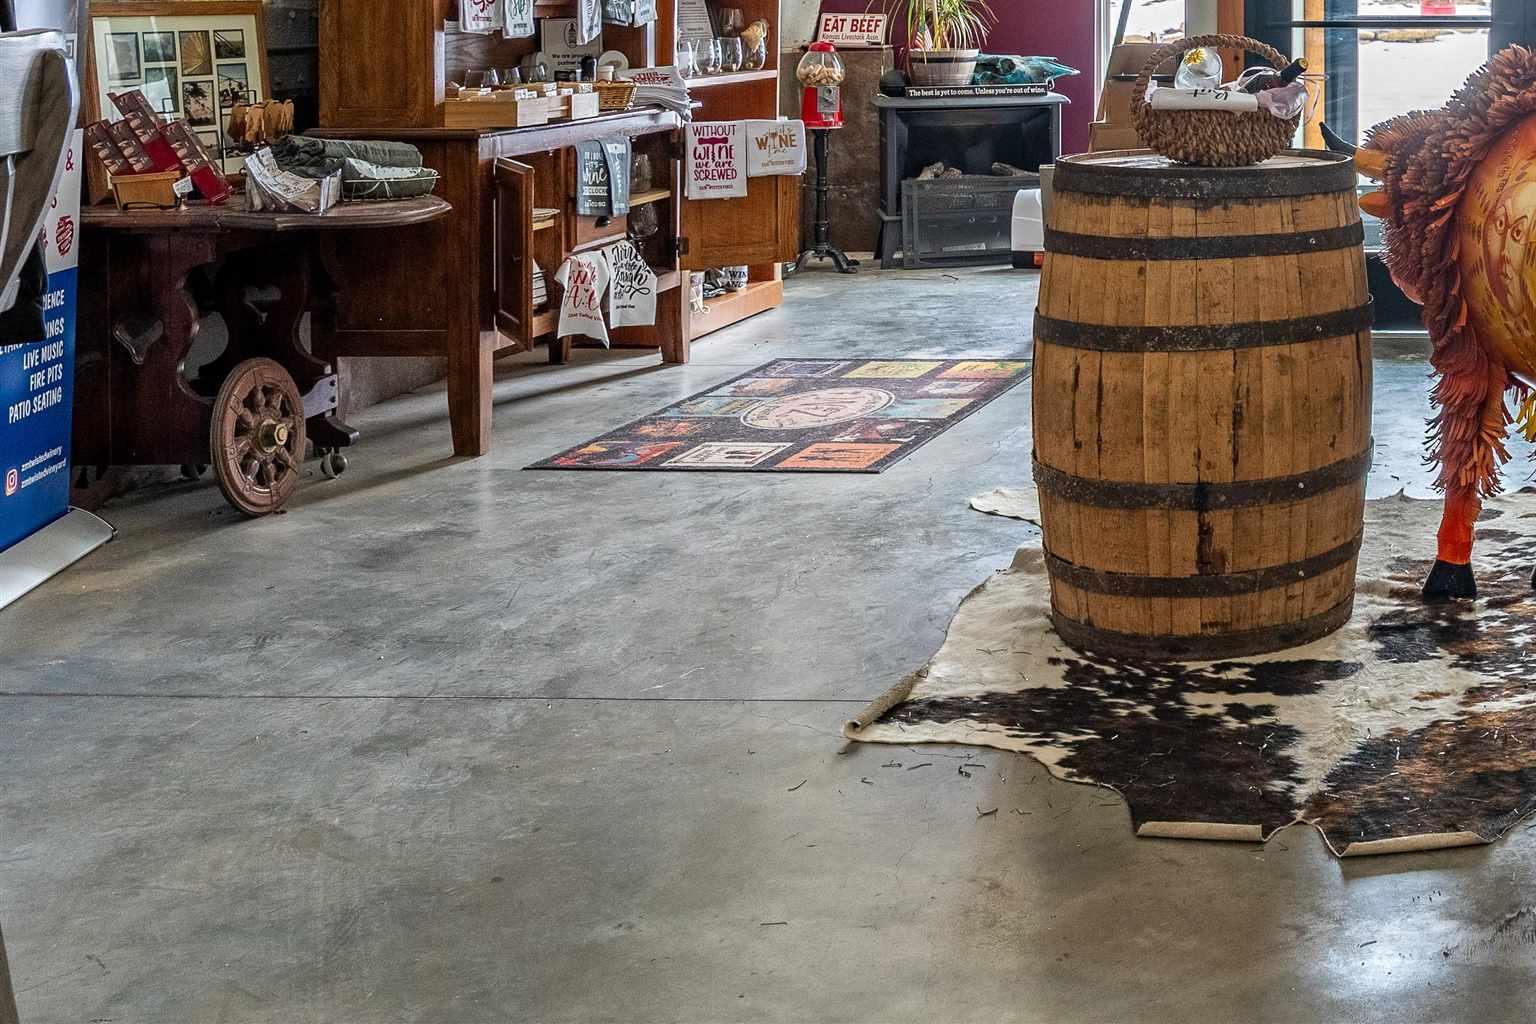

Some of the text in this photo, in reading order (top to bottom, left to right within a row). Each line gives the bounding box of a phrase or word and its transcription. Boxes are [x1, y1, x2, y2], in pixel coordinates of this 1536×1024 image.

[823, 18, 882, 33] EAT BEEF
[841, 33, 865, 41] Livestock
[940, 89, 950, 97] yet
[995, 87, 1013, 95] you're
[1030, 86, 1046, 94] wine.
[692, 125, 736, 136] WITHOUT
[755, 134, 798, 150] WINE
[694, 168, 738, 182] SCREWED
[23, 349, 39, 370] LIVE
[41, 340, 64, 364] MUSIC
[30, 363, 63, 392] FIRE PITS
[8, 386, 62, 424] PATIO SEATING
